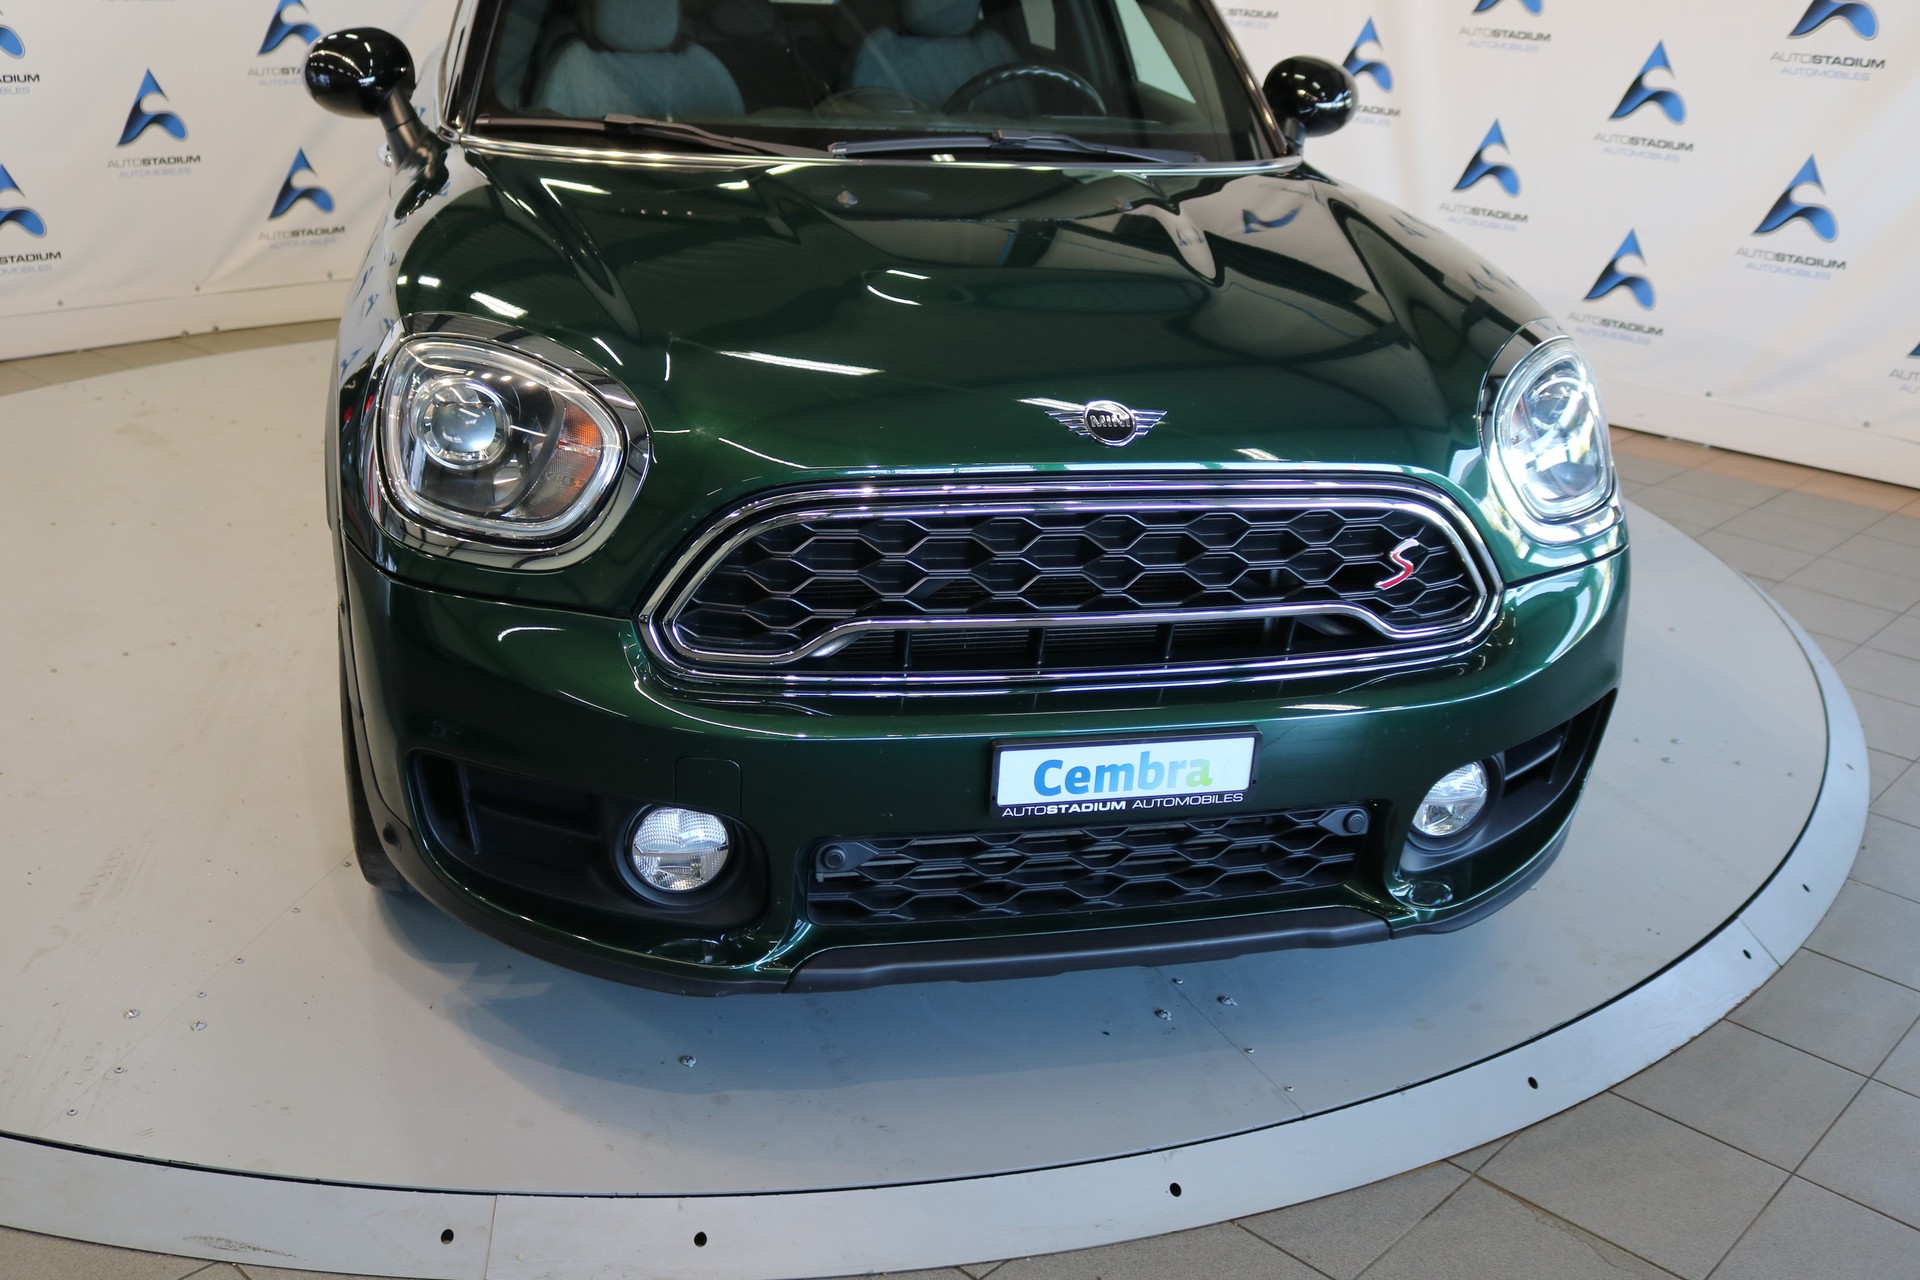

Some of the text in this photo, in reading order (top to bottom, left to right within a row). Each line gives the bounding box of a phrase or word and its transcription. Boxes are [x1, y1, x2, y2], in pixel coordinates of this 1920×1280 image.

[1459, 26, 1552, 42] AUTOSTADIUM
[1469, 40, 1539, 53] AUTOMOBILES
[1771, 51, 1886, 70] AUTOSTADIUM
[1780, 66, 1870, 81] AUTOMOBILES
[1594, 132, 1694, 152] AUTOSTADIUM
[107, 155, 201, 168] AUTOSTADIUM
[1603, 146, 1681, 163] AUTOMOBILES
[119, 167, 192, 178] AUTOMOBILES
[1439, 202, 1529, 222] AUTOSTADIUM
[1448, 215, 1517, 232] AUTOMOBILES
[258, 226, 346, 240] AUTOSTADIUM
[1736, 247, 1847, 270] AUTOSTADIUM
[1745, 263, 1832, 280] AUTOMOBILES
[1569, 312, 1663, 336] AUTOSTADIUM
[1089, 414, 1131, 428] MINI
[1374, 538, 1420, 591] S
[1034, 751, 1213, 797] Cembra
[1002, 793, 1243, 817] AUTOSTADIUM AUTOMOBILES
